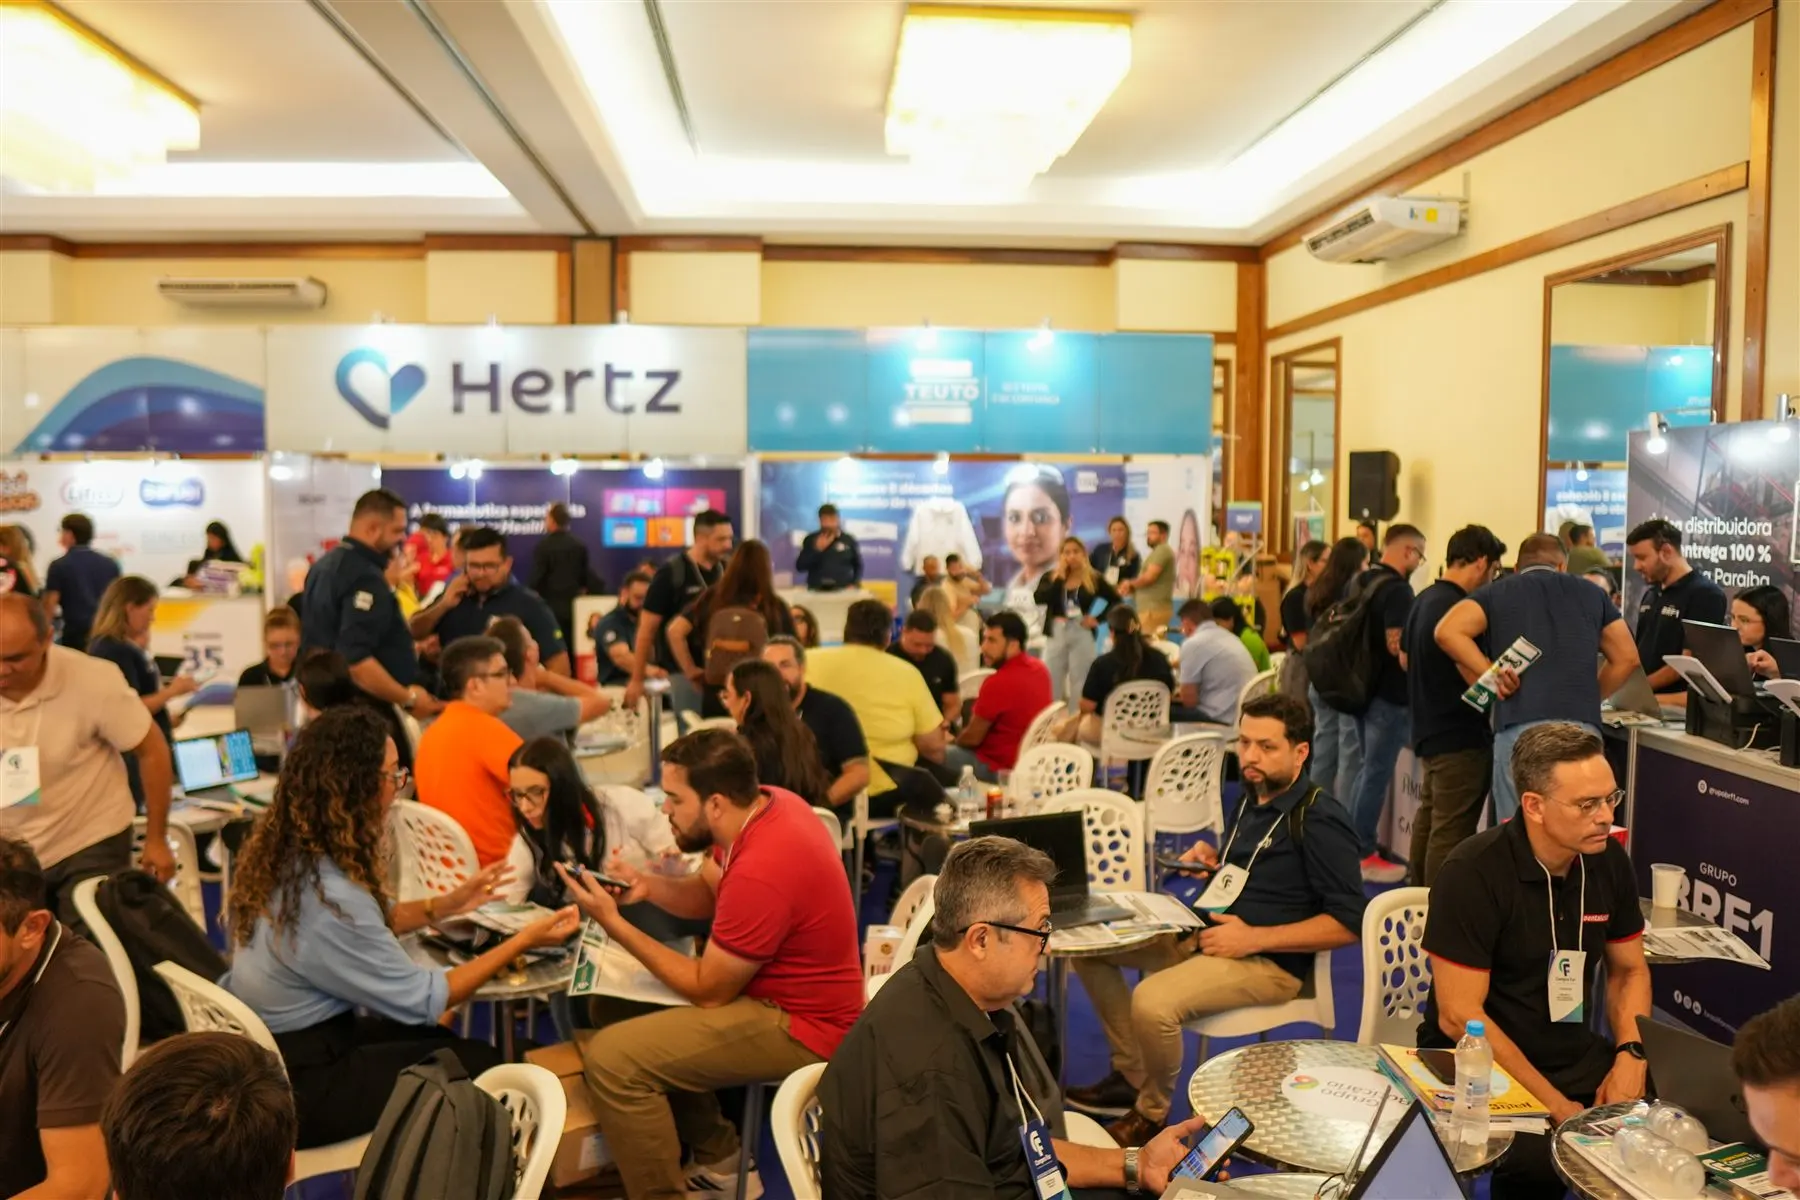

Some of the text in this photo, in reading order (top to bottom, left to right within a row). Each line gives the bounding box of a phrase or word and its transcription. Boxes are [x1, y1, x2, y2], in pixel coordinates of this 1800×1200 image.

[452, 361, 682, 414] Hertz
[904, 383, 980, 401] TEUTO
[1685, 516, 1772, 536] distribuidora
[1730, 543, 1755, 562] 100
[1757, 544, 1772, 563] %
[183, 645, 224, 672] 35
[1699, 861, 1738, 887] GRUPO
[1320, 1088, 1380, 1107] Grupo
[1326, 1080, 1409, 1105] Boicário
